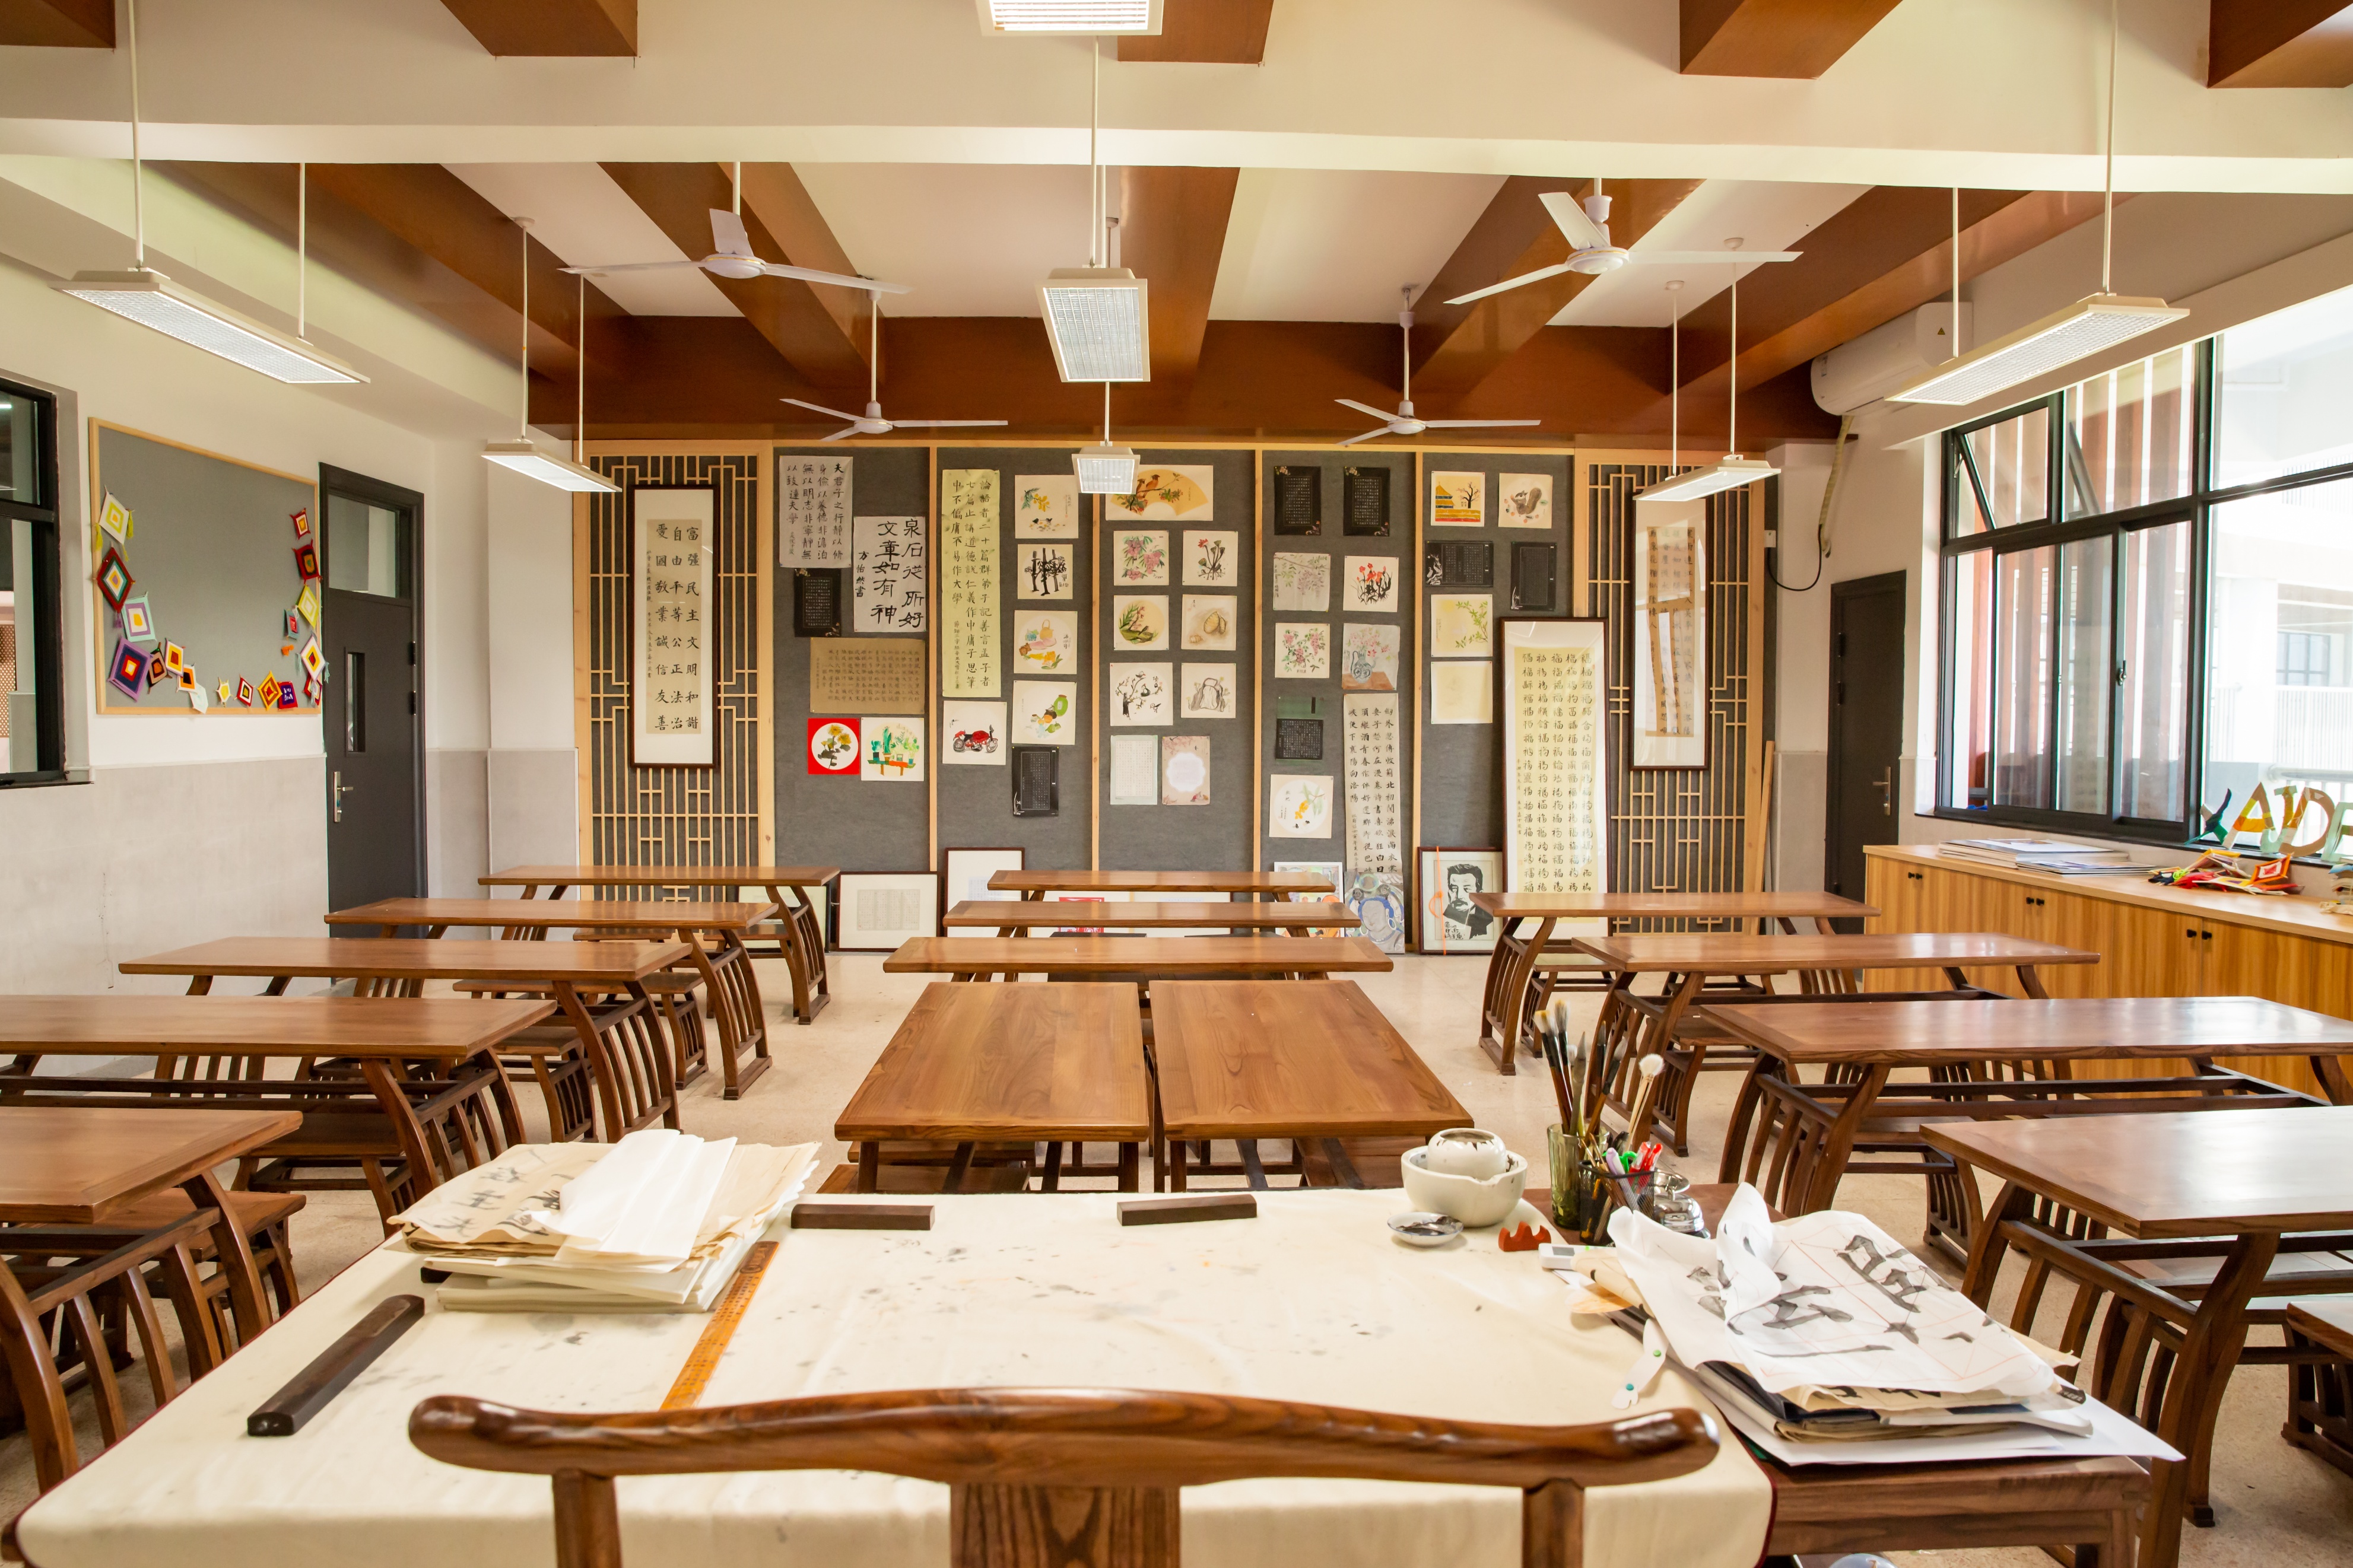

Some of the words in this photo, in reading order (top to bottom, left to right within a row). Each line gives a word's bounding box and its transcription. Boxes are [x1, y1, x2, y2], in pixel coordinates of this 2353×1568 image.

[655, 523, 669, 731] 愛國敬業誠信友善
[669, 526, 684, 730] 自由平等公正法治
[871, 521, 900, 624] 文章如有神
